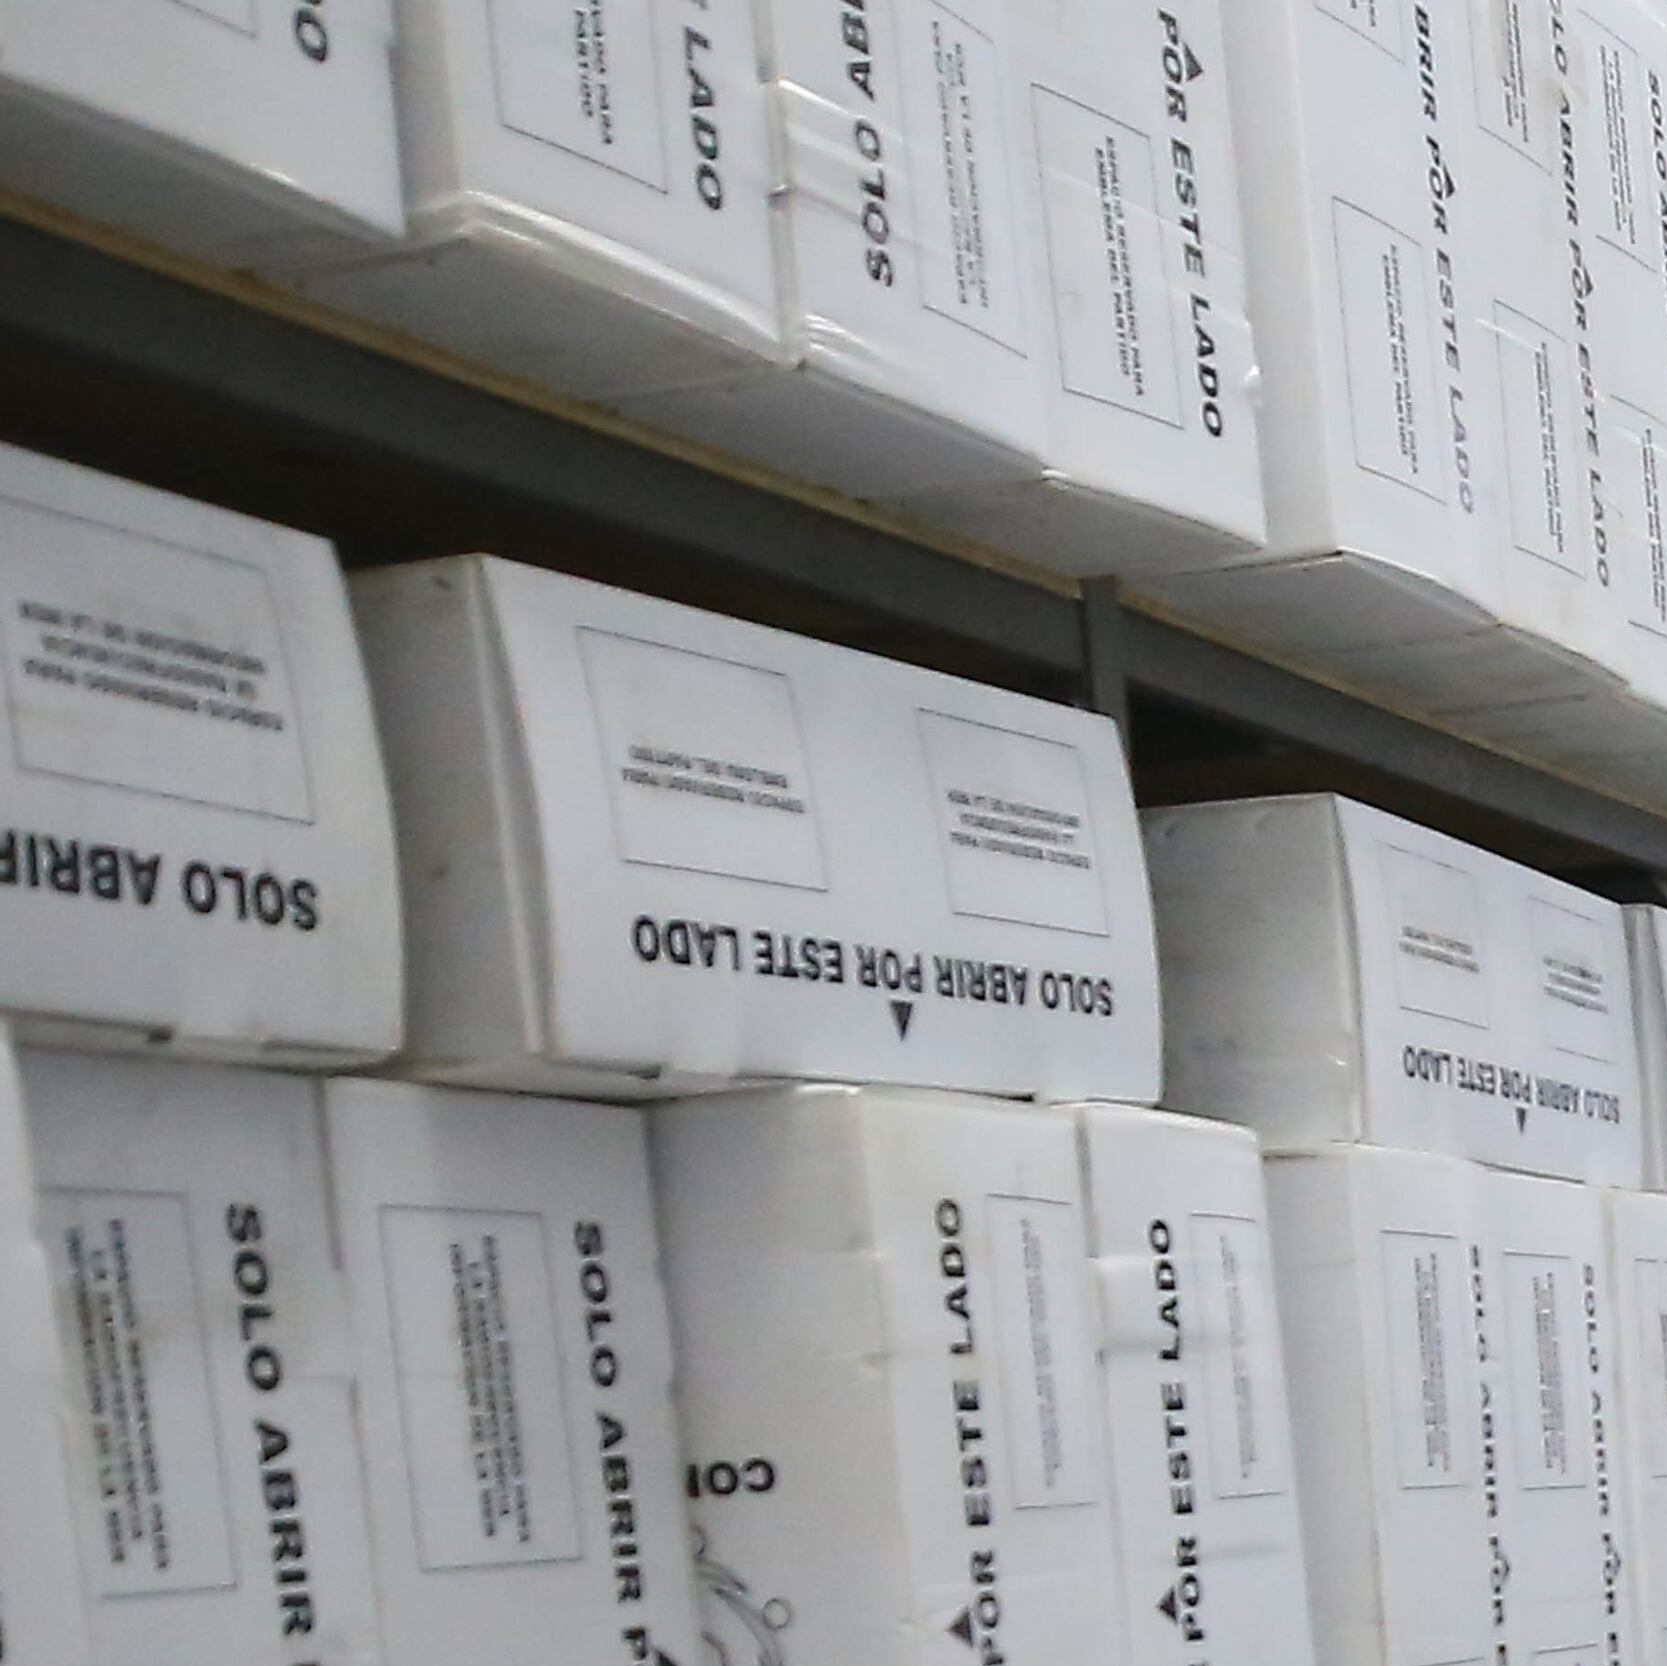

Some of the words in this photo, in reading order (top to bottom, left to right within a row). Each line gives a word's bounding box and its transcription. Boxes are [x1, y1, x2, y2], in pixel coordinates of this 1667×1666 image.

[684, 28, 722, 210] LADO
[1157, 10, 1187, 122] POR
[1408, 0, 1436, 120] BRIR
[1425, 135, 1447, 234] POR
[1647, 70, 1667, 180] SOLO
[854, 121, 893, 286] SOLO
[1170, 138, 1204, 276] ESTE
[1191, 295, 1222, 437] LADO
[1435, 248, 1459, 371] ESTE
[1448, 385, 1473, 513] LADO
[181, 861, 316, 930] SOLO
[631, 914, 739, 969] LADO
[752, 930, 843, 983] ESTE
[855, 946, 922, 993] POR
[934, 956, 1027, 1004] ABRIR
[1038, 970, 1112, 1016] SOLO
[936, 1198, 973, 1355] LADO
[1149, 1219, 1181, 1361] LADO
[226, 1205, 280, 1391] SOLO
[256, 1422, 312, 1635] ABRIR
[574, 1223, 616, 1387] SOLO
[598, 1415, 641, 1601] ABRIR
[953, 1383, 991, 1526] ESTE
[1164, 1384, 1194, 1515] ESTE
[971, 1550, 1004, 1666] POR
[1177, 1537, 1204, 1641] POR
